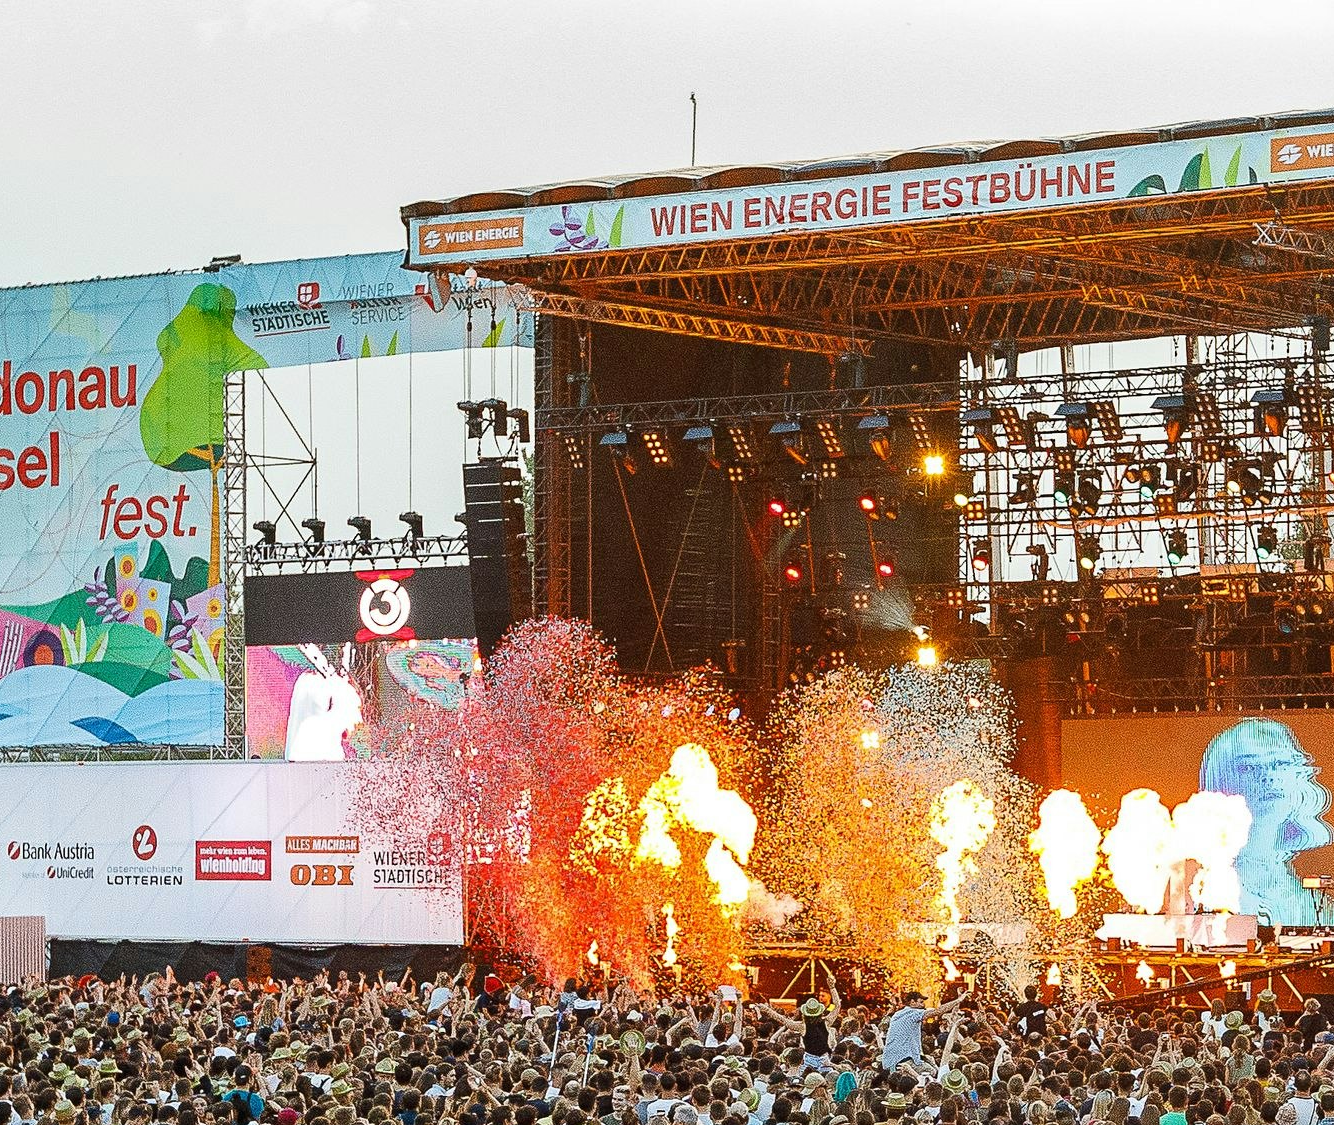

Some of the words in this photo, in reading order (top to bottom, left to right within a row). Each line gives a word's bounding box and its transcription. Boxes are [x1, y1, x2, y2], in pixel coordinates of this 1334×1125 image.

[651, 200, 733, 237] WIEN
[744, 182, 893, 229] ENERGIE
[902, 160, 1116, 212] FESTBÜHNE
[445, 229, 473, 243] WIEN
[475, 225, 520, 242] ENERGIE
[341, 282, 394, 299] WIENER
[247, 300, 299, 316] WIENER
[351, 306, 405, 325] SERVICE
[252, 310, 330, 333] STÄDTISCHE
[99, 485, 197, 541] fest.
[22, 842, 50, 860] Bank
[54, 842, 94, 860] Austria
[287, 840, 310, 851] ALLES
[373, 851, 425, 867] WIENER
[56, 866, 94, 880] UniCredit
[107, 875, 183, 886] LOTTERIEN
[290, 864, 355, 886] OBI
